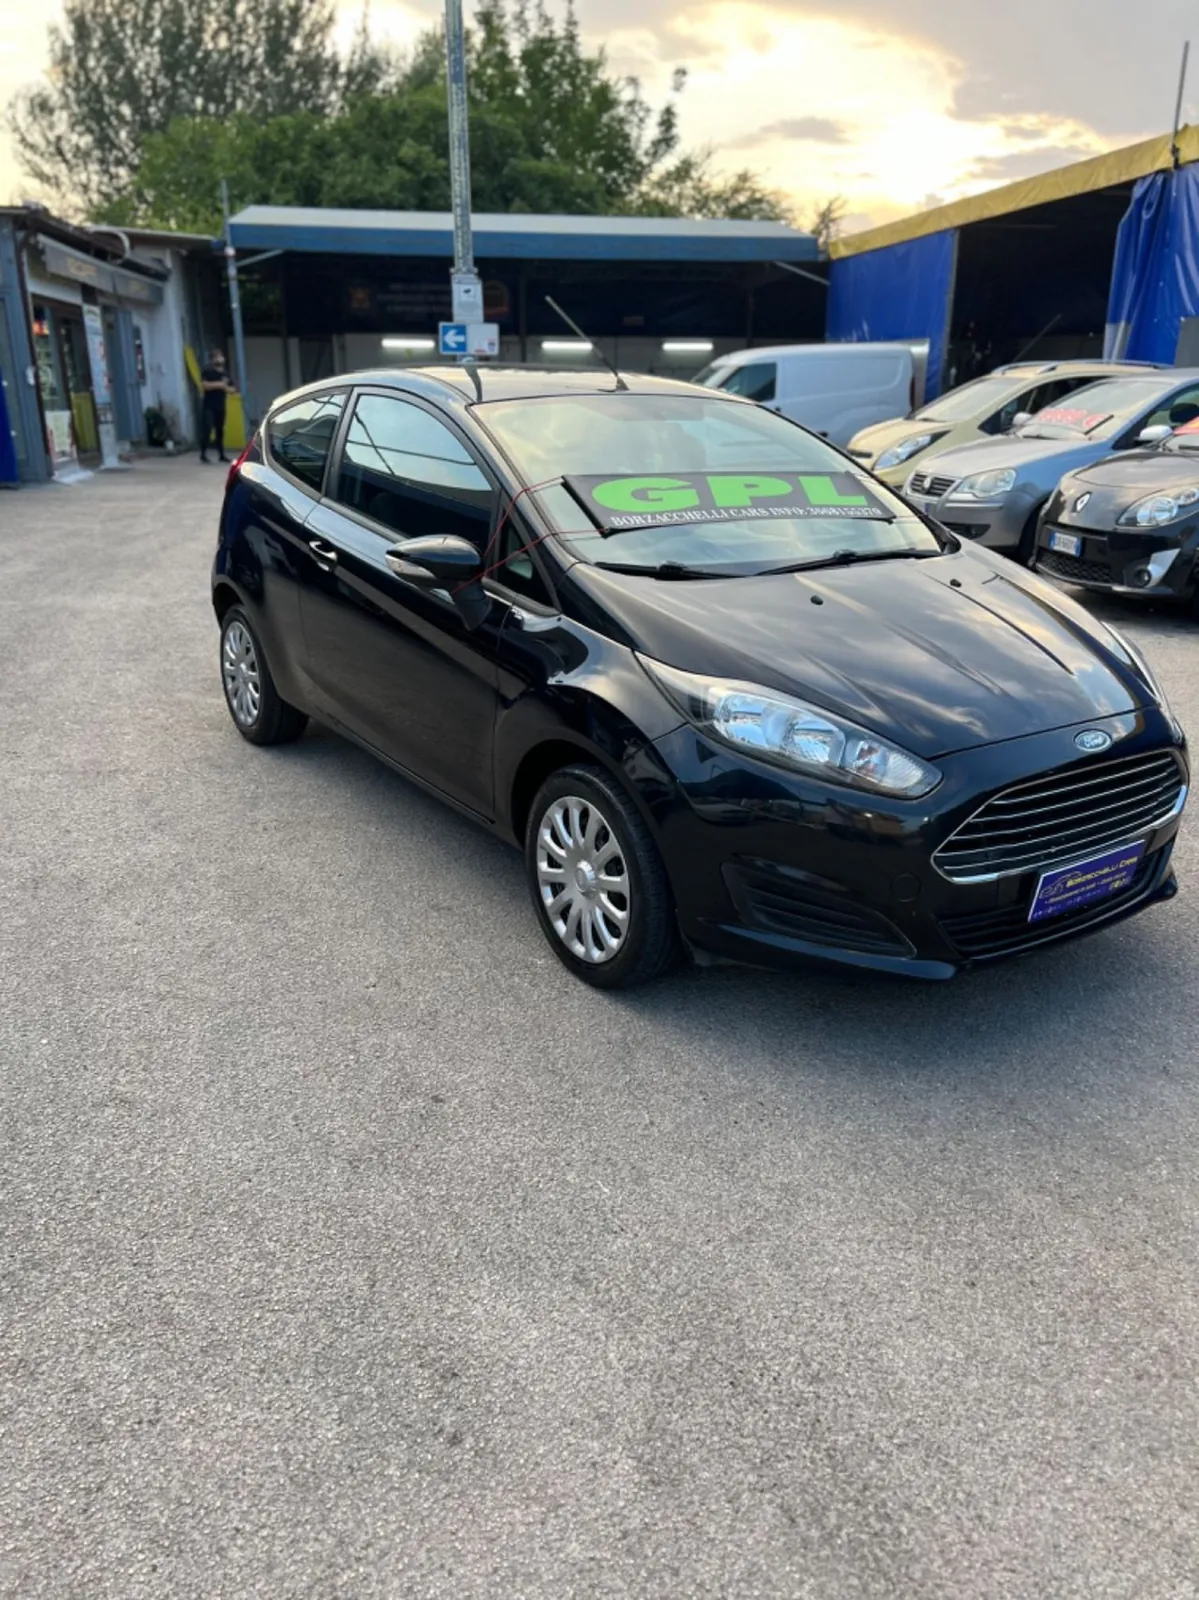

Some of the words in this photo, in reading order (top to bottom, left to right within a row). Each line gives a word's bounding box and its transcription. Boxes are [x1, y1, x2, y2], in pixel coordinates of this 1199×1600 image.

[592, 475, 868, 513] GPL
[610, 508, 728, 527] BORZACCHELLI
[729, 507, 769, 518] CARS
